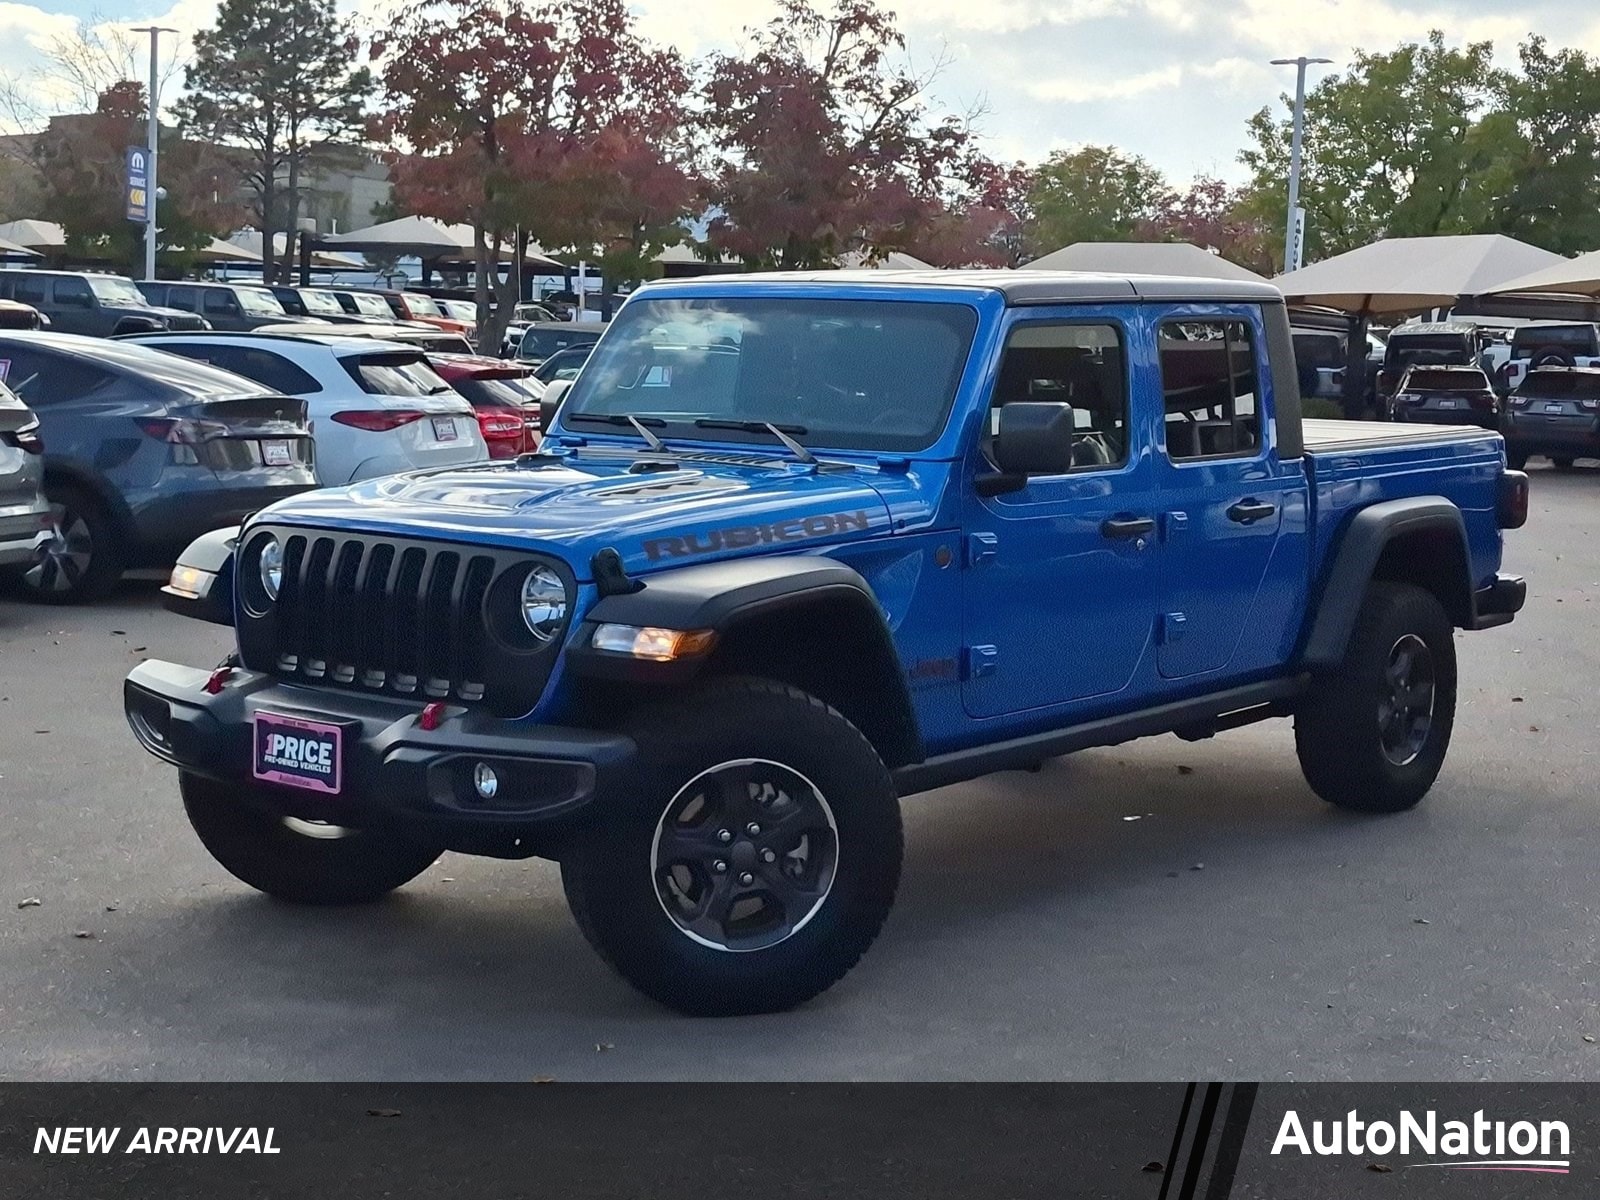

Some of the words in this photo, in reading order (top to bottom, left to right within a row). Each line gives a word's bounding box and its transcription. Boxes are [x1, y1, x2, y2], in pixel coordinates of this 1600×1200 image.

[643, 511, 869, 561] RUBICON
[264, 755, 299, 768] PRE-OWNED
[300, 762, 331, 773] VEHICLES
